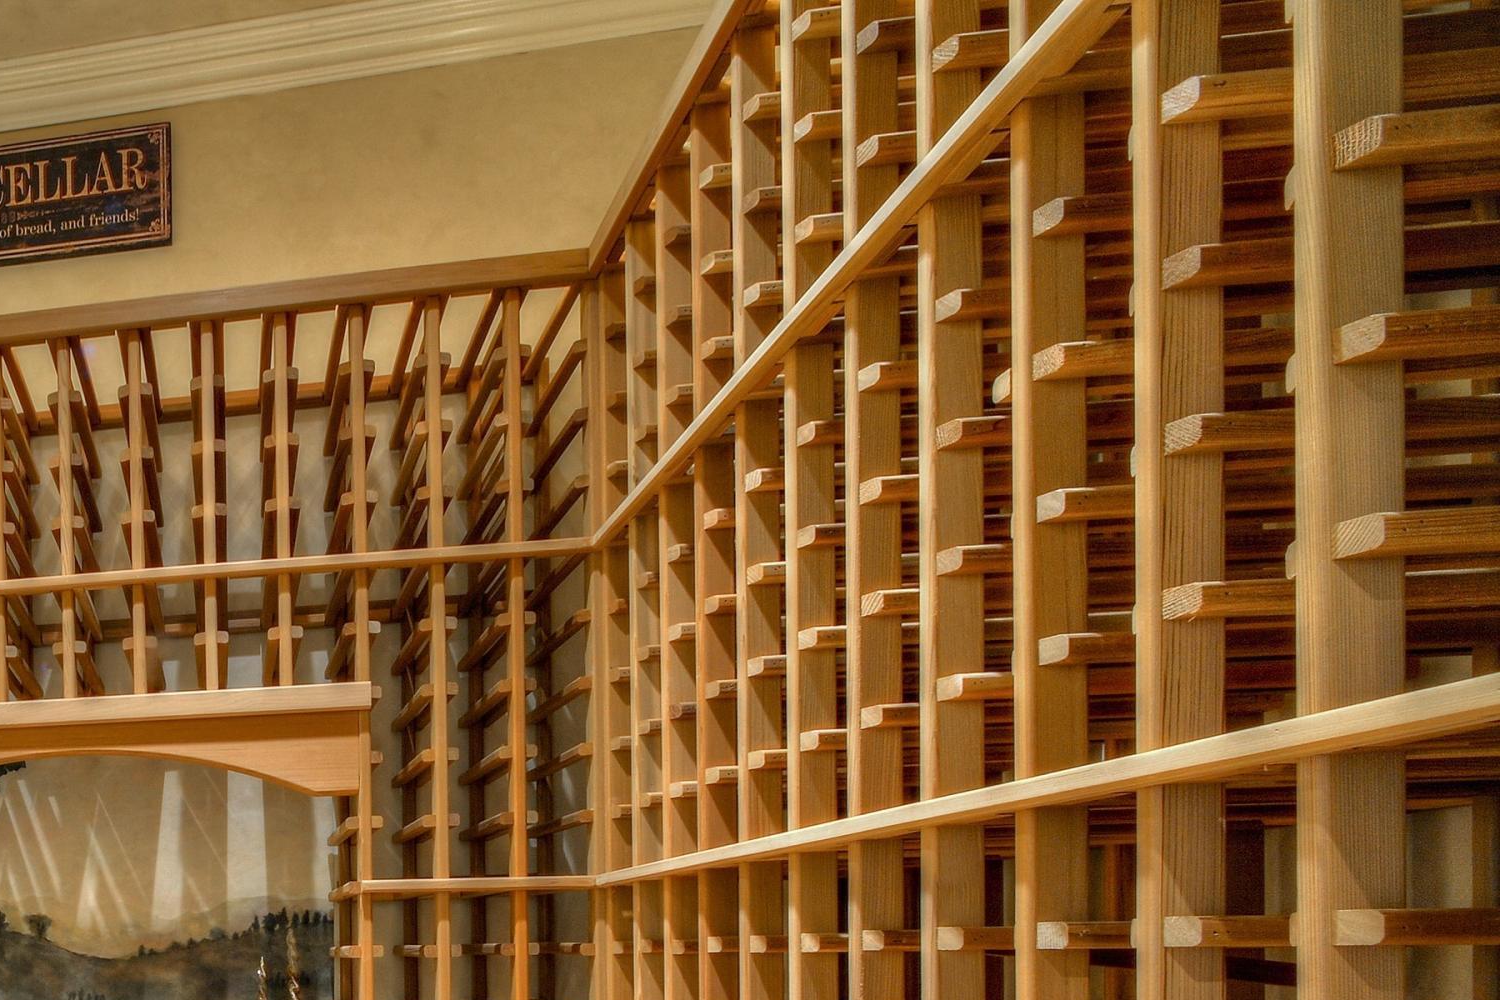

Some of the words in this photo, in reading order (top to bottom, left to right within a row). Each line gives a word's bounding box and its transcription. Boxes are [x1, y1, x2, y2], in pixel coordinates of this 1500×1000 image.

[0, 225, 13, 239] of
[15, 219, 56, 236] bread,
[60, 214, 85, 231] and
[89, 208, 140, 227] friends!
